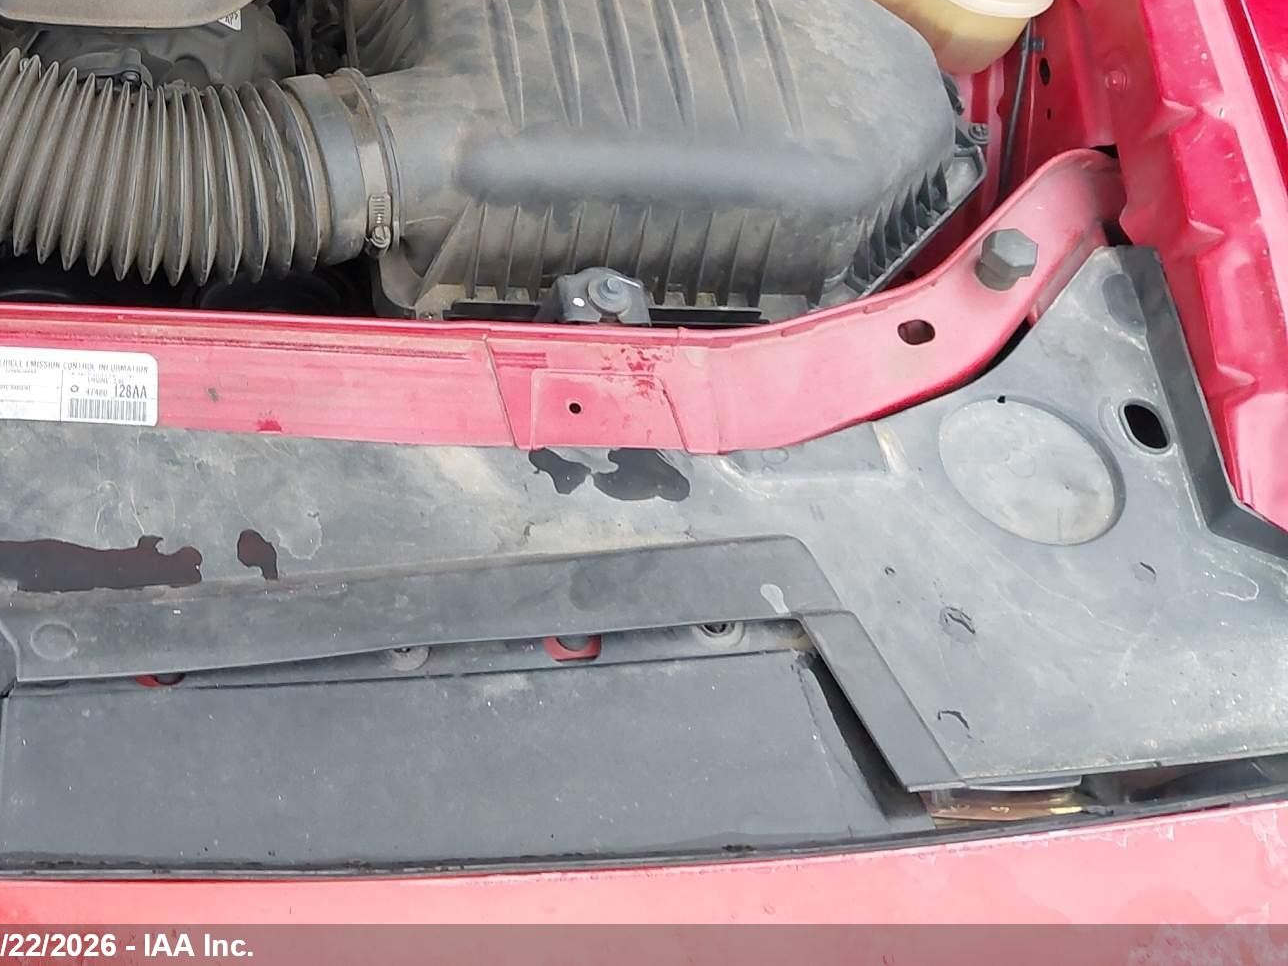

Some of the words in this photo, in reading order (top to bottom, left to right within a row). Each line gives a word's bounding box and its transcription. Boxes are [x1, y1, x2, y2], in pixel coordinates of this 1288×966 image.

[26, 360, 60, 370] EMISSION
[63, 361, 94, 371] CONTROL
[99, 363, 148, 373] INFORMATION
[114, 384, 147, 399] 128AA
